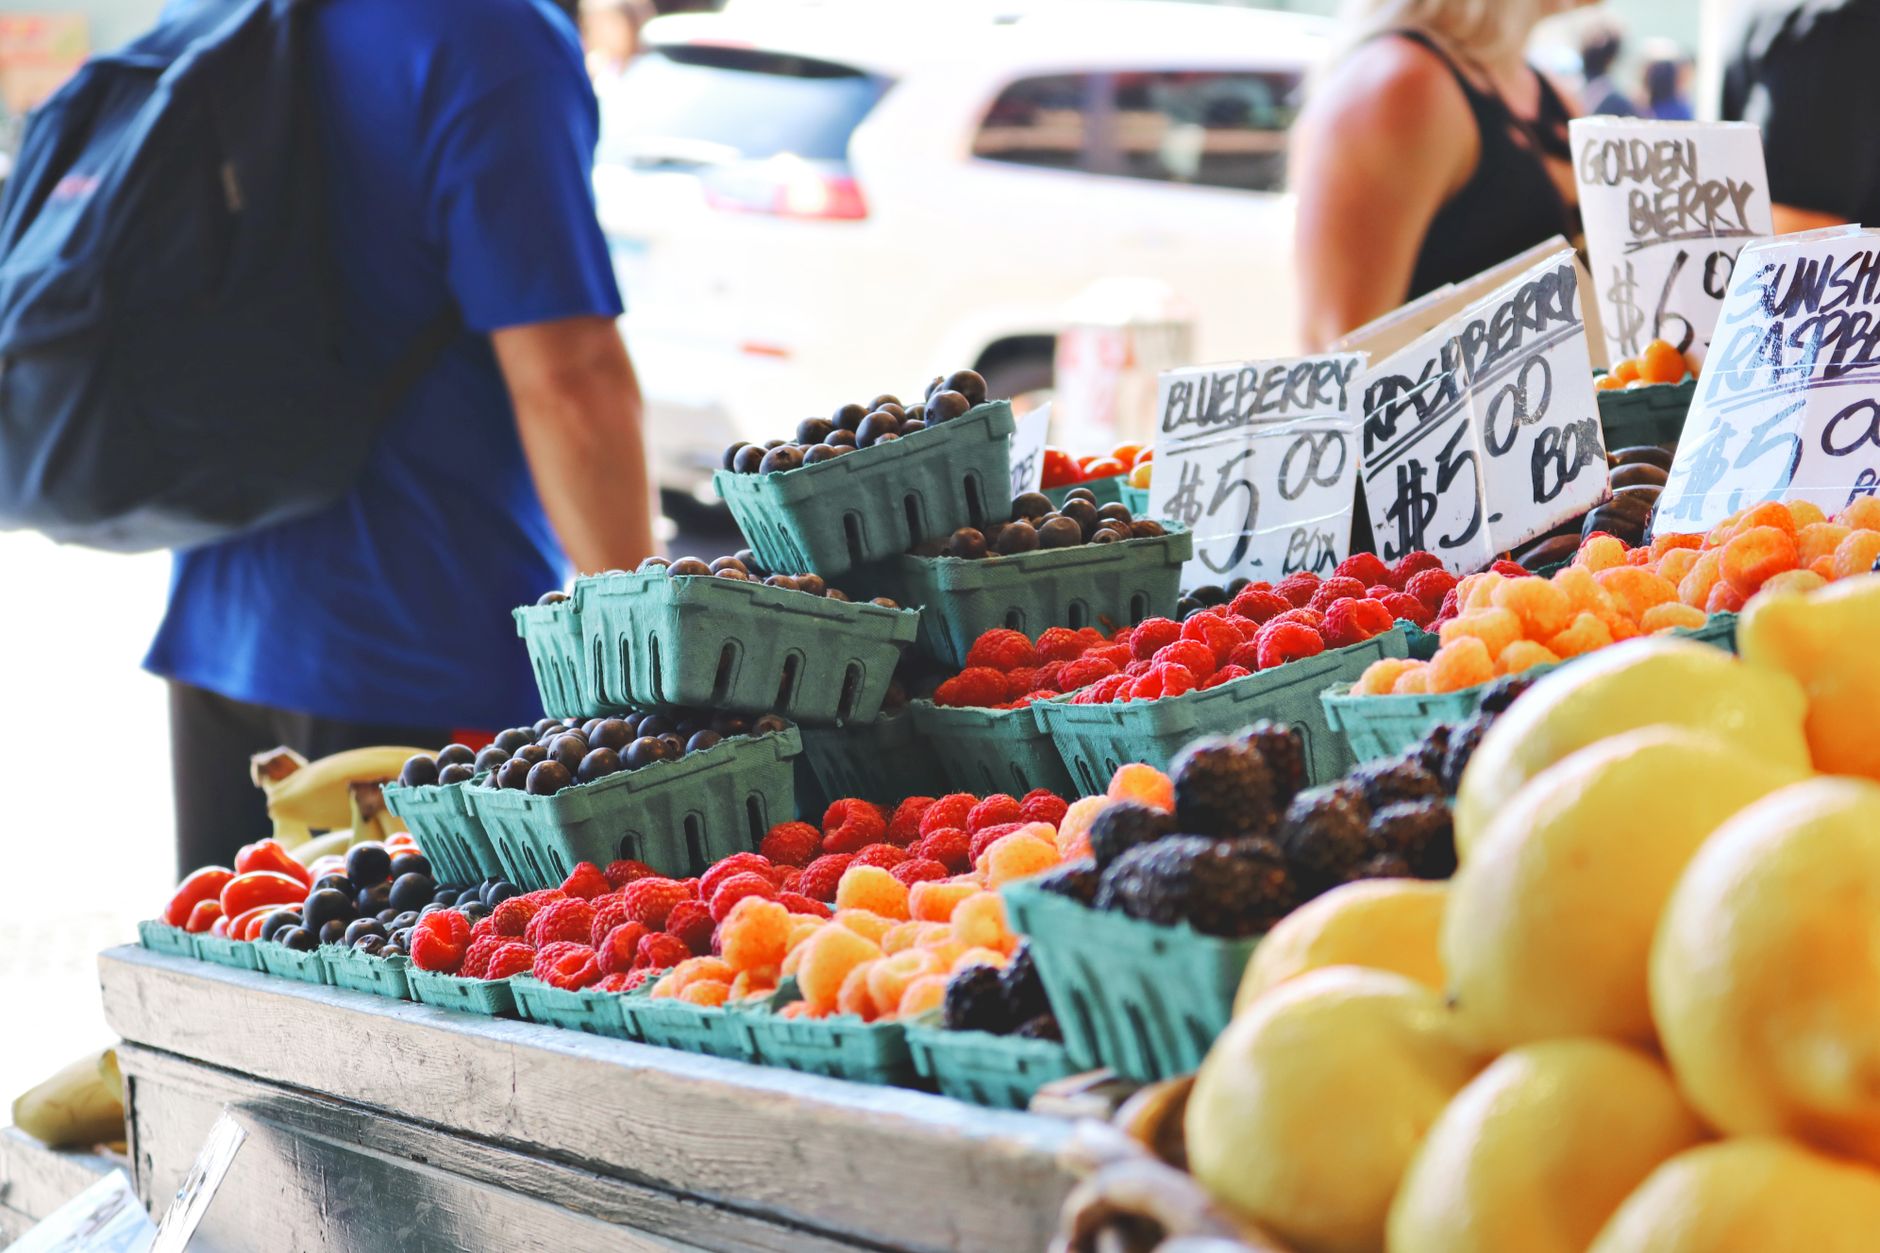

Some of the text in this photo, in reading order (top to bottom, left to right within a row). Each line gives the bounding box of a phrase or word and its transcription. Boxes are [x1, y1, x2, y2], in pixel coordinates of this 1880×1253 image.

[1579, 138, 1699, 190] GOLDEN
[1628, 176, 1754, 238] BERRY
[1726, 251, 1880, 324] SUNSH
[1162, 358, 1359, 433] BLUEBERRY
[1363, 264, 1579, 459] RASPBERRY
[1531, 417, 1607, 504] BOX
[1282, 527, 1339, 576] BOX
